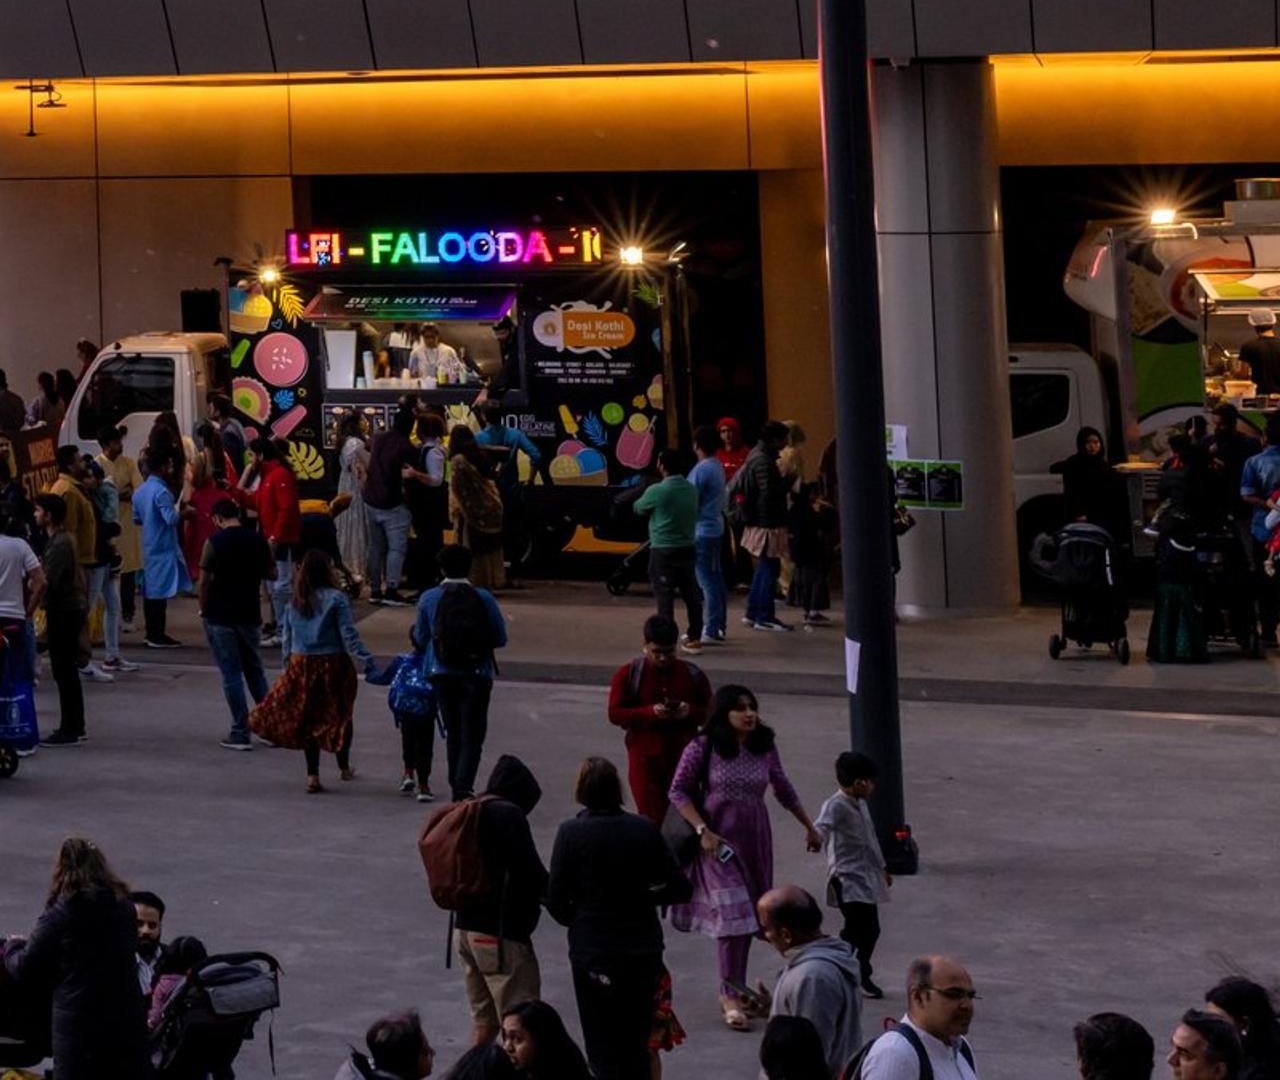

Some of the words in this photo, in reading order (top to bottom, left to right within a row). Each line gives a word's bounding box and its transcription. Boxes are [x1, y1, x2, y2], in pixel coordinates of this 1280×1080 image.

[371, 232, 553, 264] FALOODA
[567, 320, 592, 331] Desi
[595, 320, 624, 331] Kothi
